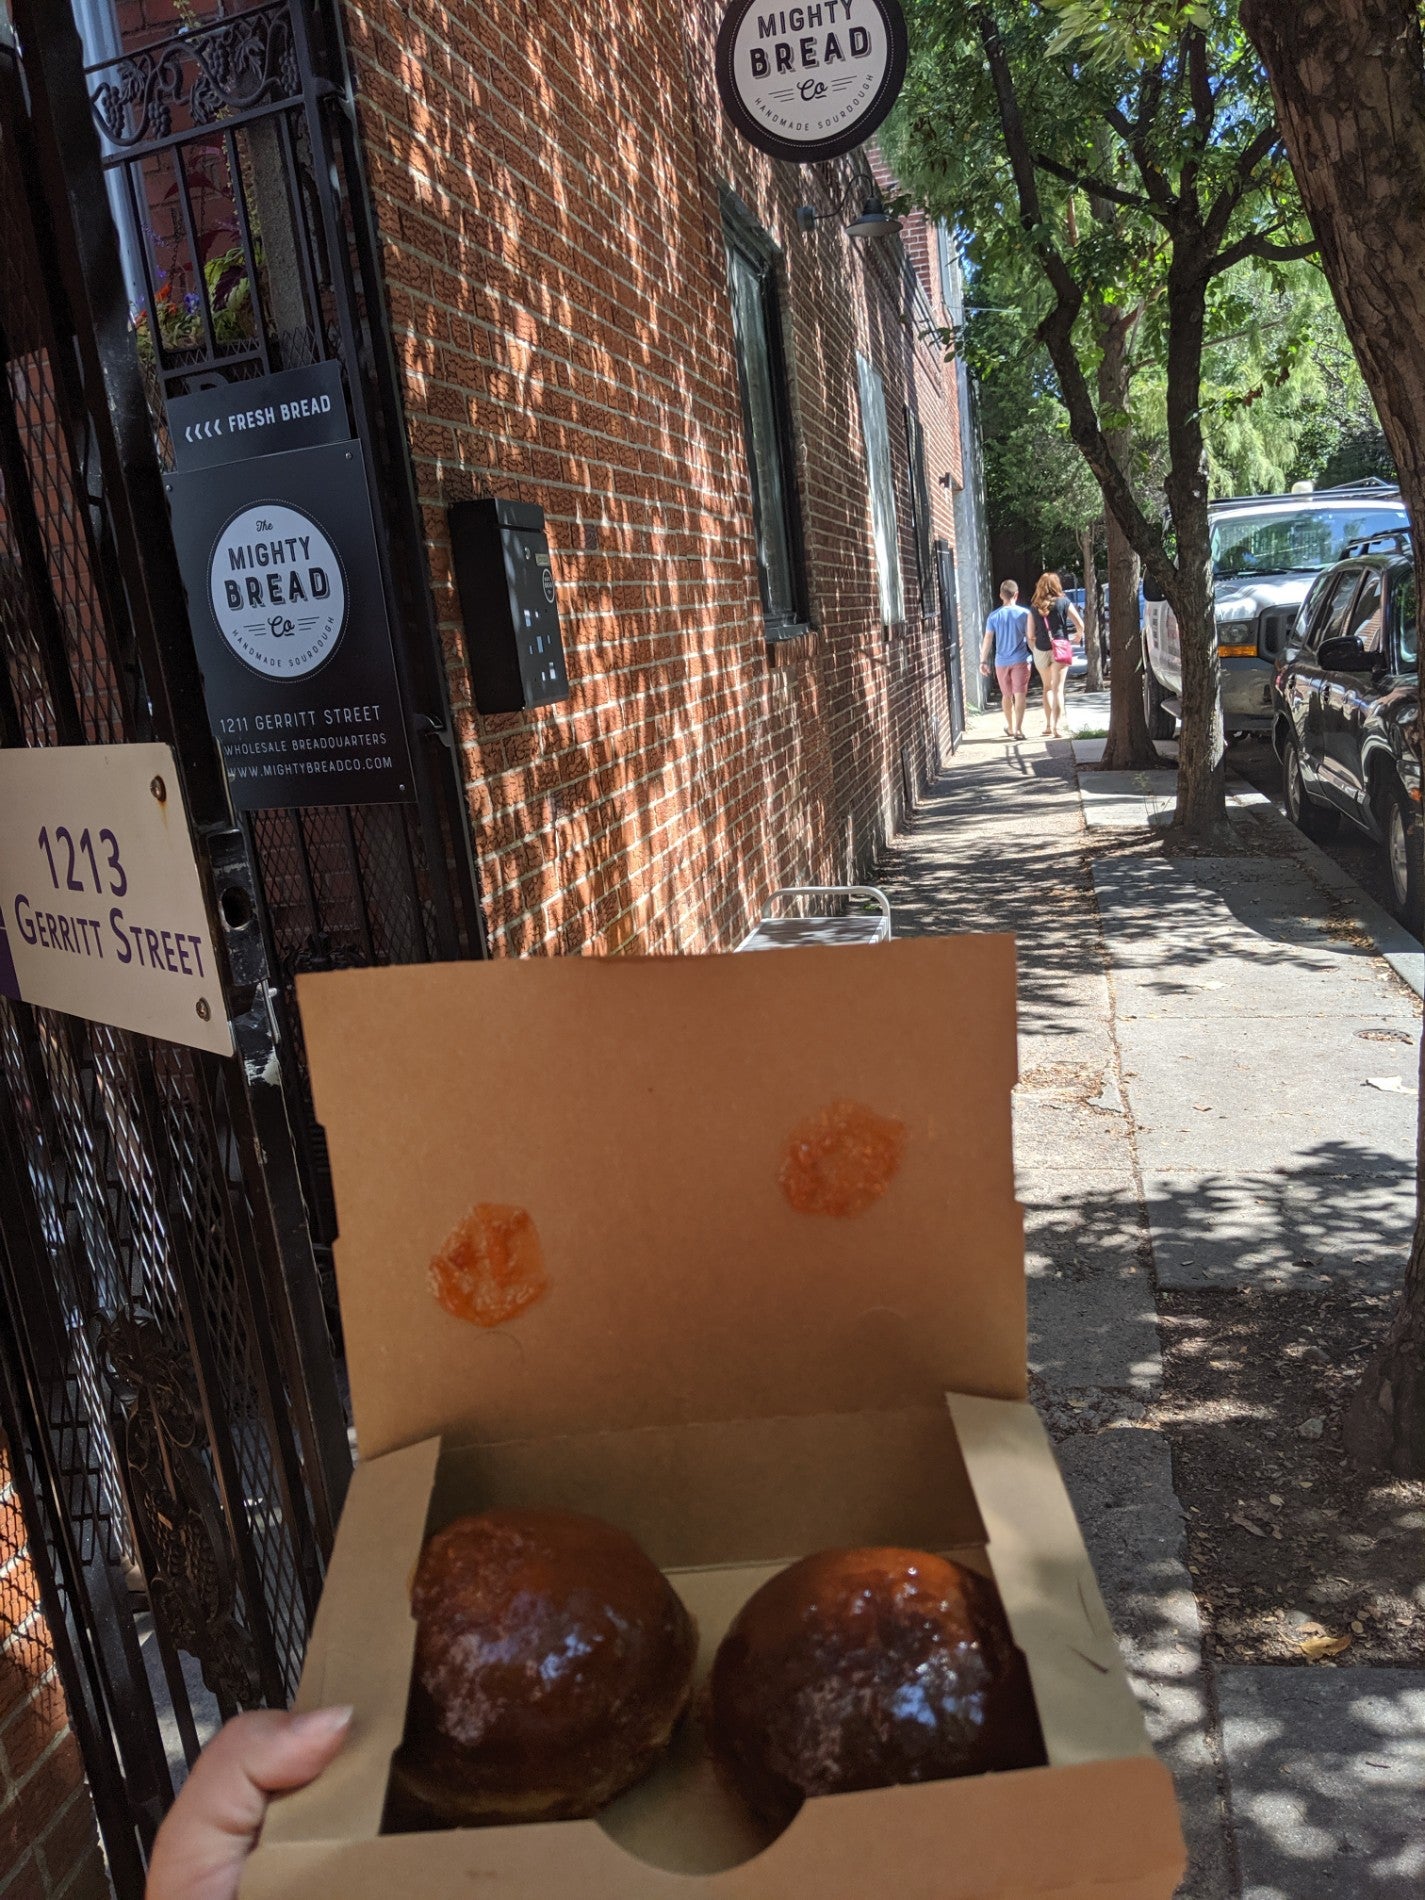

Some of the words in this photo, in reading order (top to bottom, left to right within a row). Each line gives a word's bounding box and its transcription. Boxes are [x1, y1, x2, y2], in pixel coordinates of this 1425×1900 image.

[757, 0, 853, 39] MIGHTY
[750, 26, 871, 79] BREAD
[754, 97, 809, 131] HANDMADE
[818, 74, 874, 129] SOURDOUGH
[797, 79, 828, 101] Co
[228, 407, 276, 433] FRESH
[280, 395, 331, 422] BREAD
[256, 520, 273, 532] The
[228, 536, 311, 571] MIGHTY
[224, 567, 330, 611] BREAD
[232, 629, 282, 668] HANDMADE
[288, 616, 335, 668] SOURDOUGH
[267, 615, 296, 638] Co
[220, 716, 248, 734] 1211
[255, 710, 316, 731] GERRITT
[324, 704, 381, 726] STREET
[224, 740, 287, 756] WHOLESALE
[292, 732, 388, 752] BREADQUARTERS
[227, 756, 394, 779] WWW.MIGHTYBREADCO.COM
[38, 825, 128, 897] 1213
[14, 893, 104, 959] GERRITT
[109, 907, 205, 978] STREET
